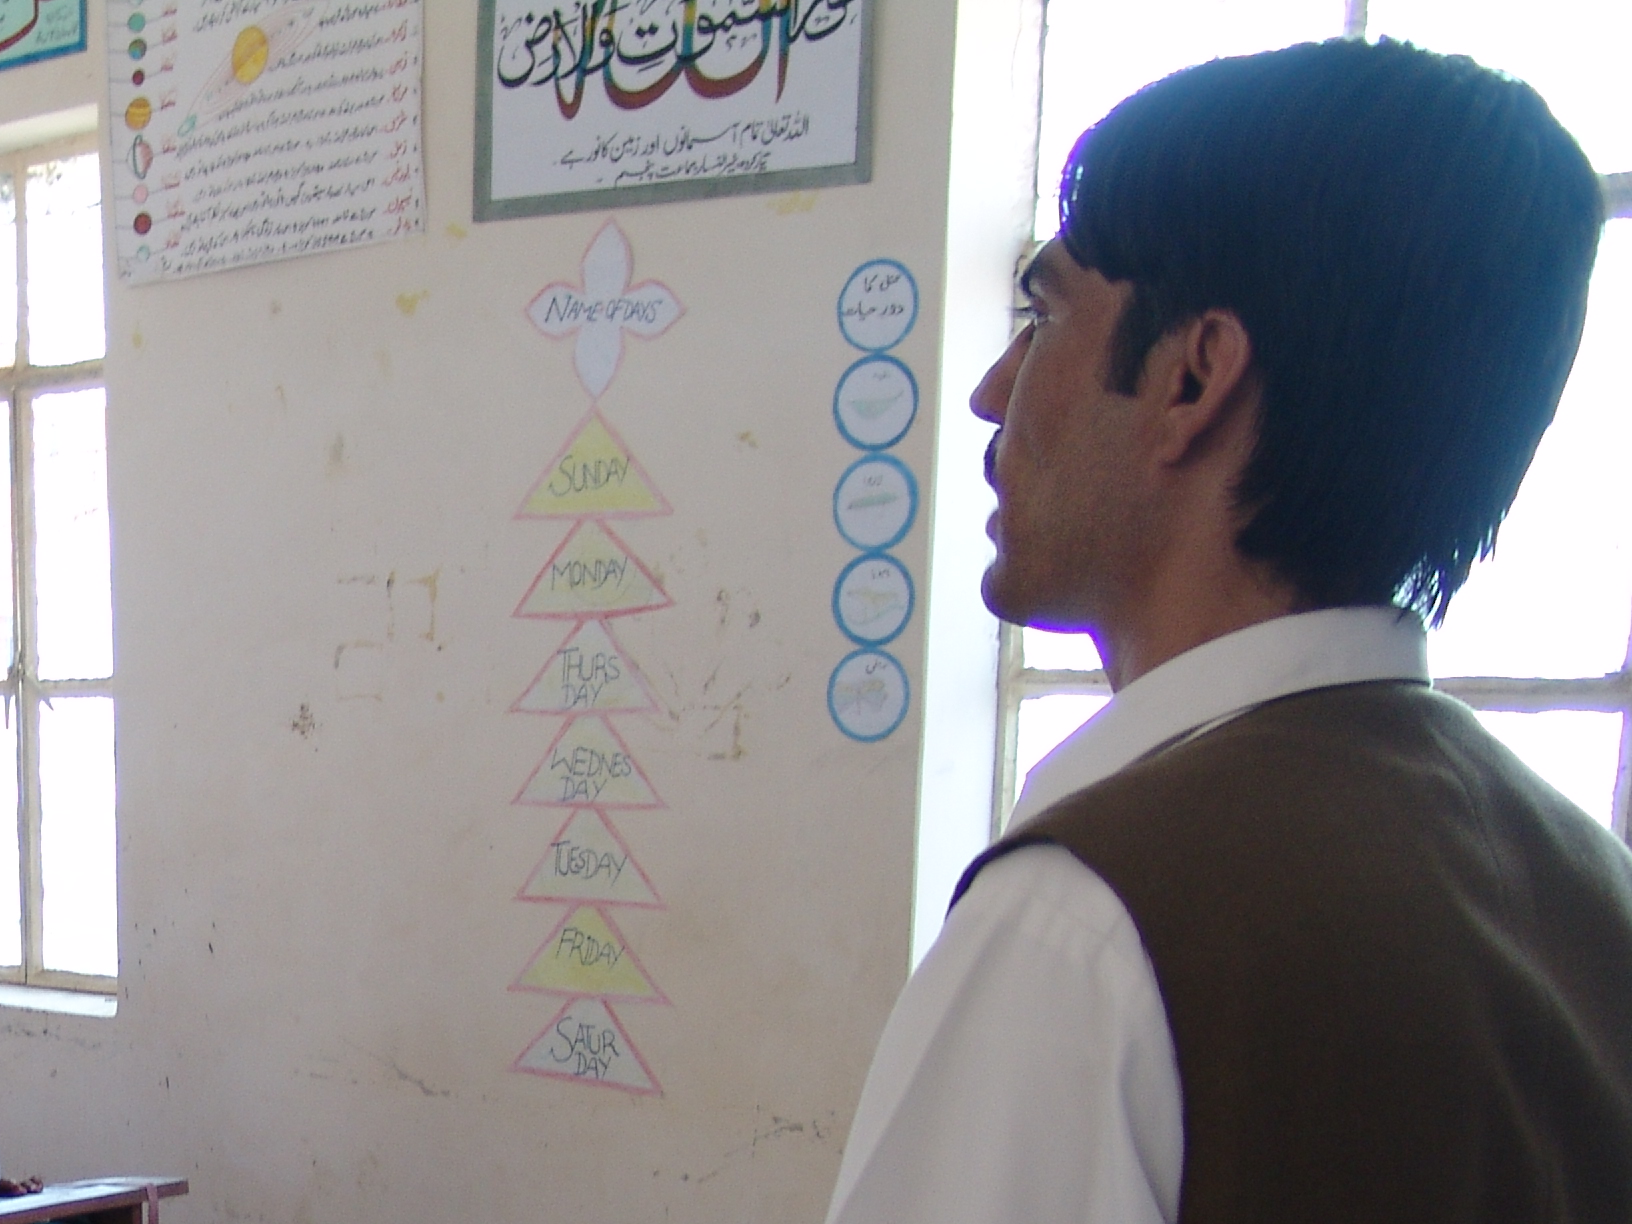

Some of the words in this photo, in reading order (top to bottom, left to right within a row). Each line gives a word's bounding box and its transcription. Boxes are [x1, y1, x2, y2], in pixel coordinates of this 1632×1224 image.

[548, 453, 631, 498] SUNDAY
[550, 555, 631, 592] MONDAY
[556, 646, 621, 684] THURS
[561, 681, 606, 709] DAY
[550, 746, 633, 779] WEDNES
[559, 775, 609, 802] DAY
[551, 841, 629, 886] TUESDAY
[550, 1015, 621, 1064] SATUR
[573, 1052, 613, 1081] DAY
